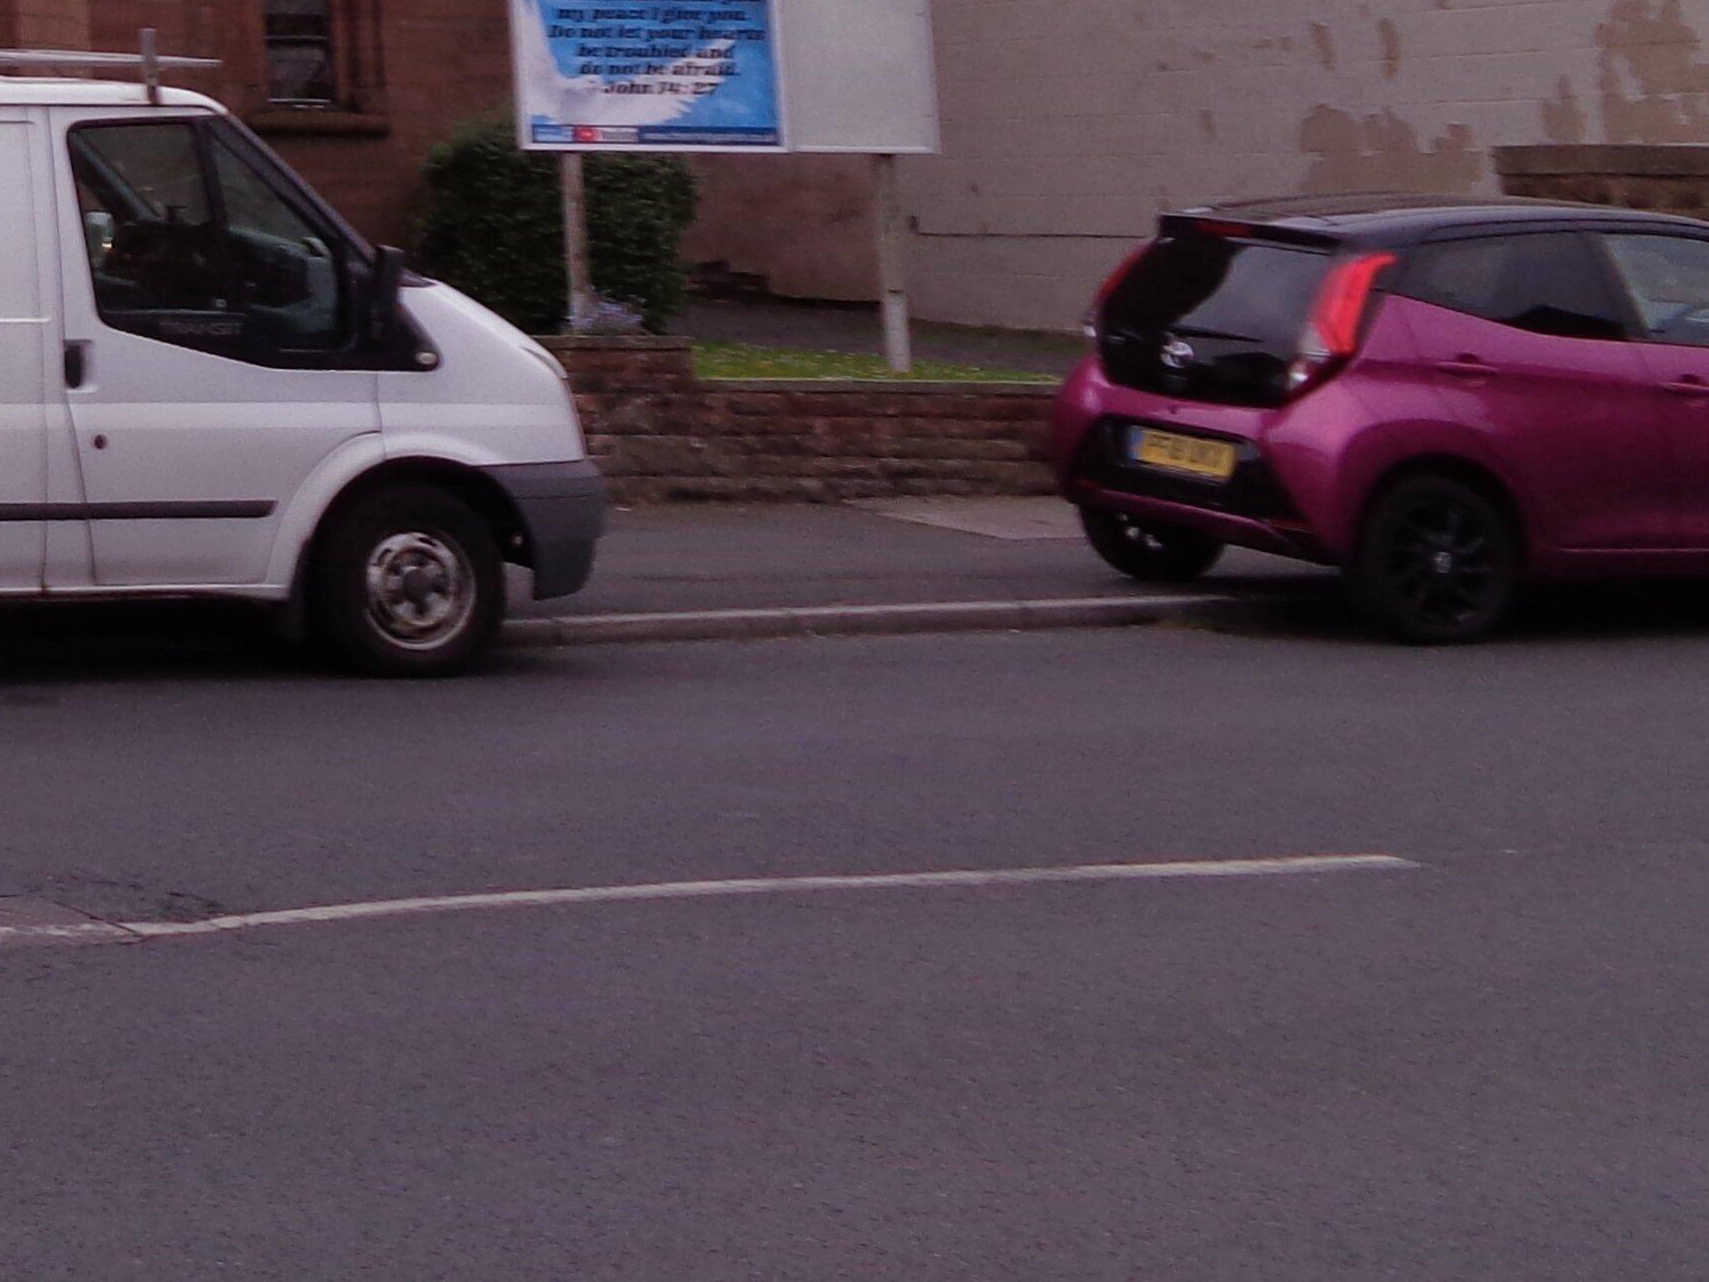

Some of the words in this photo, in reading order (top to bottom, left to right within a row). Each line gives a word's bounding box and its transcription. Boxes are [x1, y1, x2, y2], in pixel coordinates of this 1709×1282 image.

[557, 9, 585, 22] my
[591, 9, 645, 22] peace
[580, 26, 613, 38] not
[604, 43, 692, 58] troubled
[696, 44, 737, 59] and
[608, 63, 641, 76] not
[603, 81, 654, 95] John
